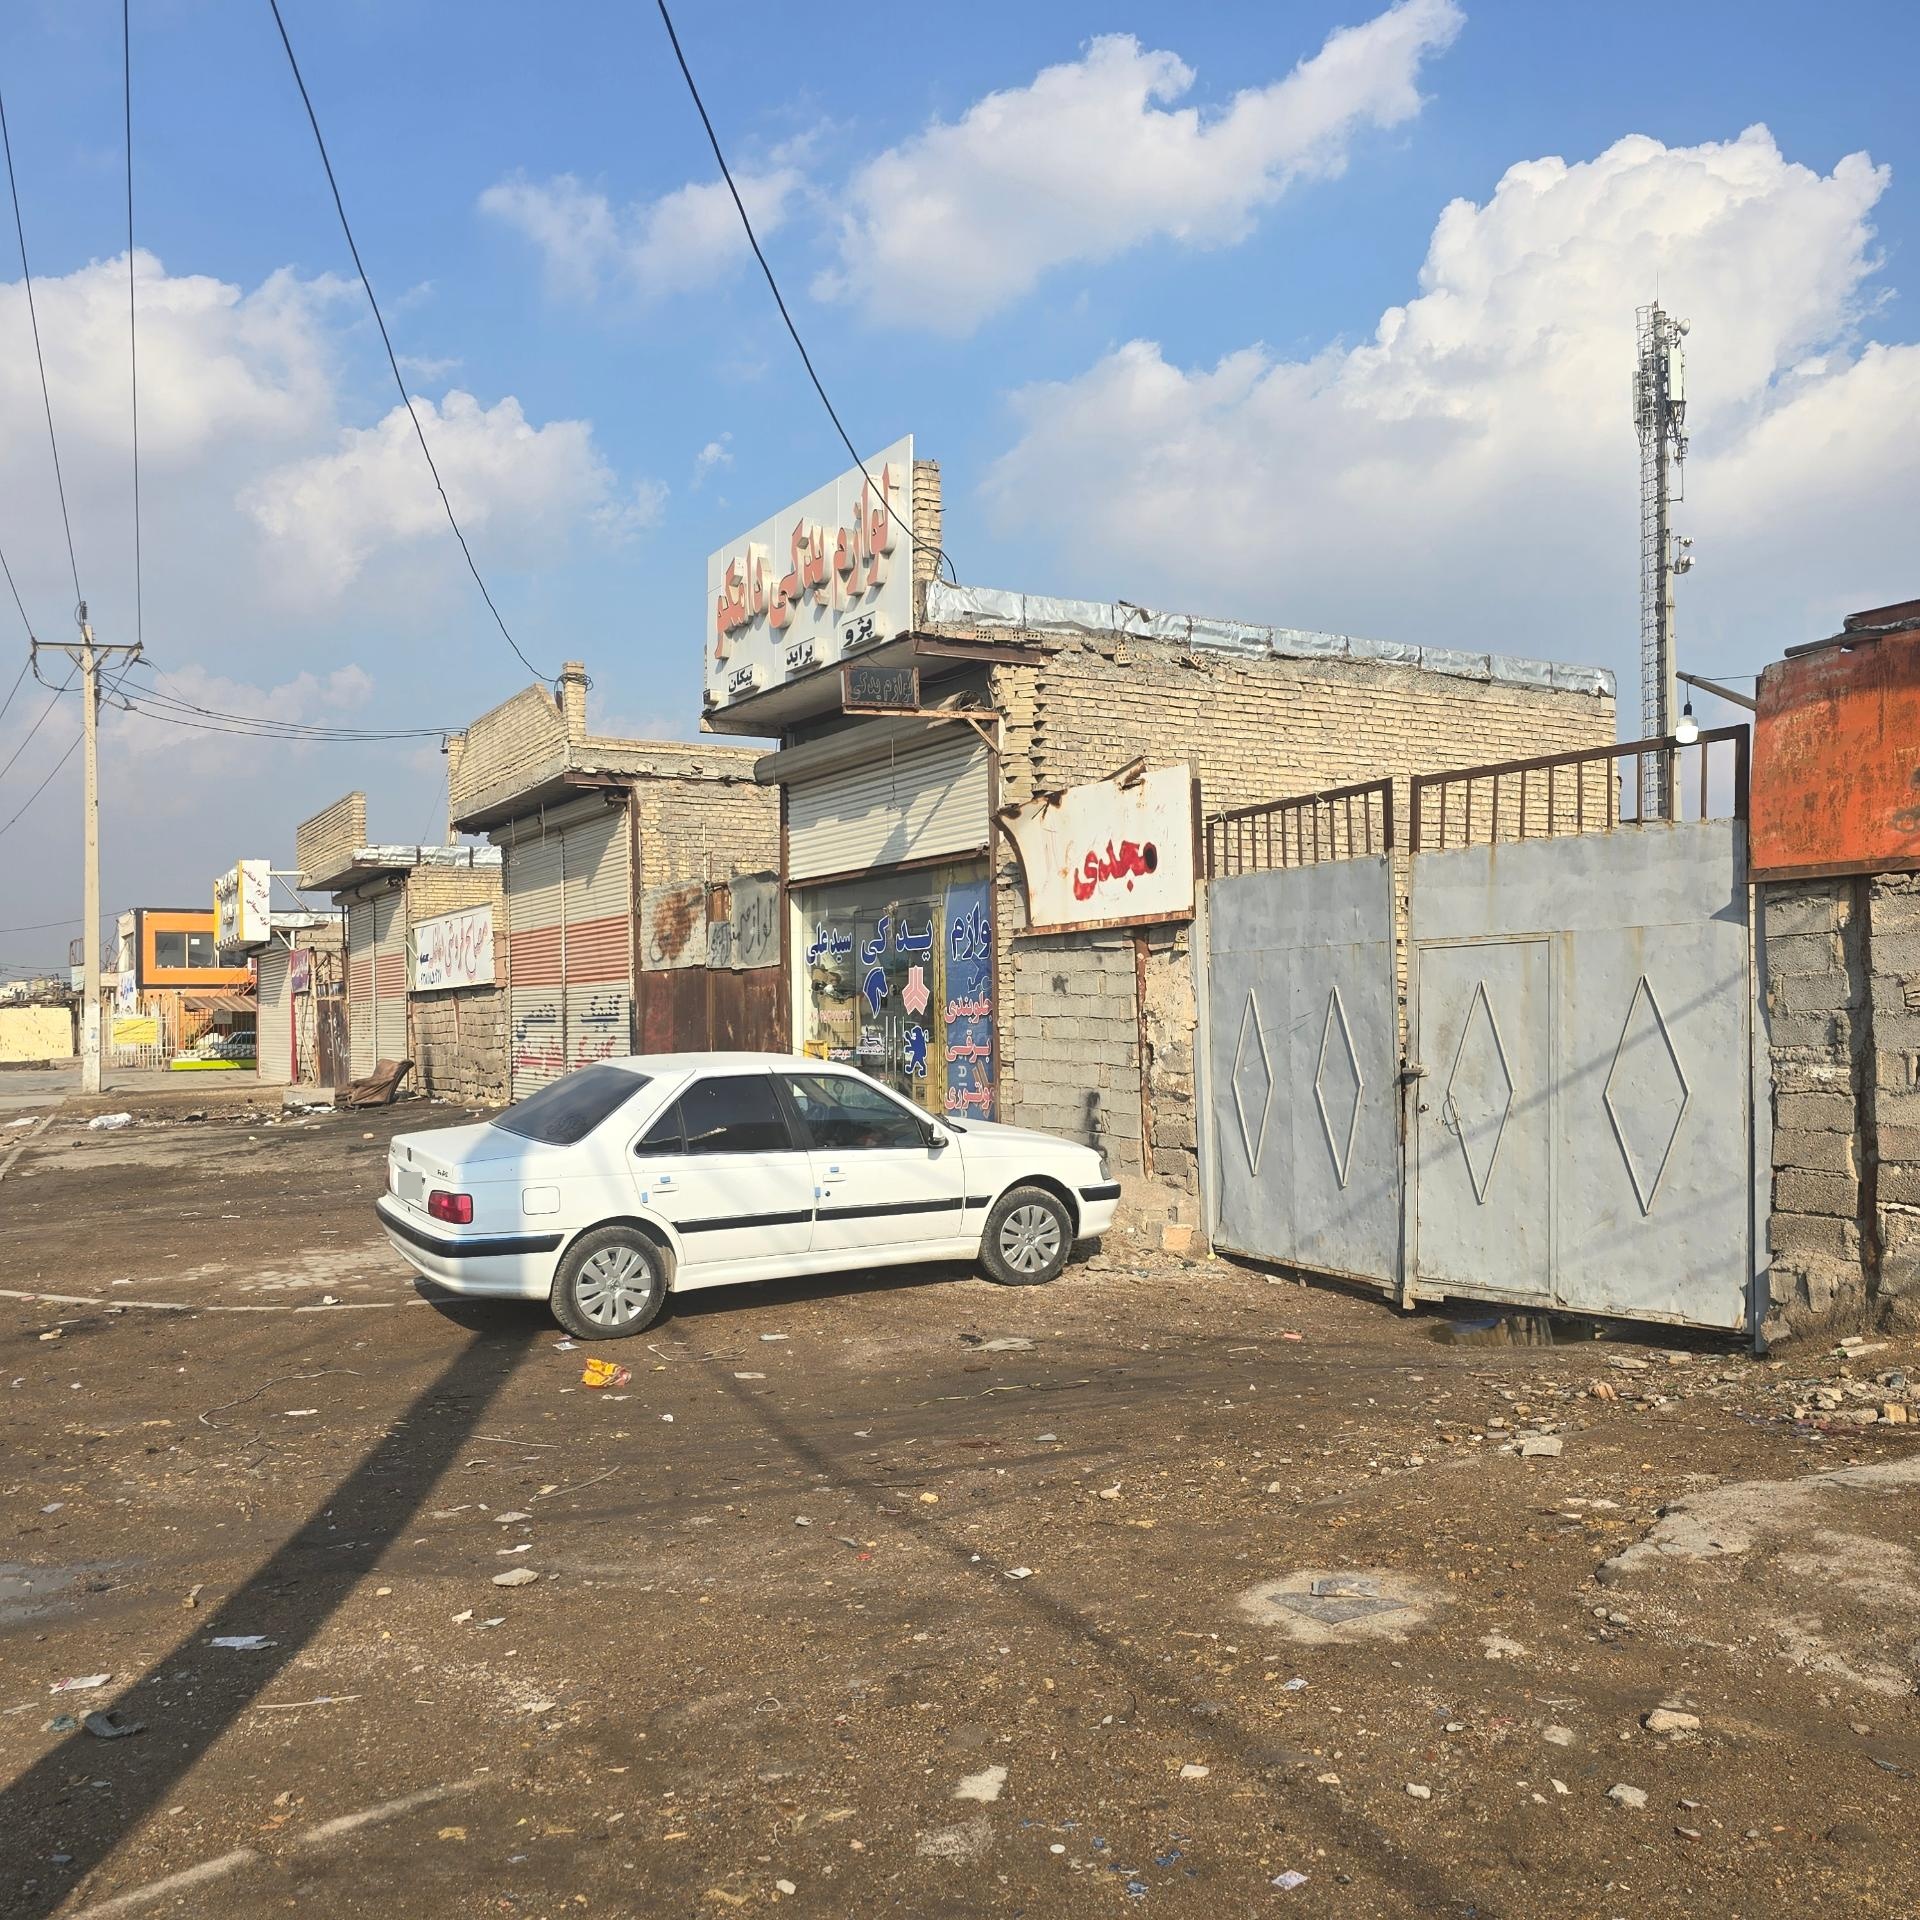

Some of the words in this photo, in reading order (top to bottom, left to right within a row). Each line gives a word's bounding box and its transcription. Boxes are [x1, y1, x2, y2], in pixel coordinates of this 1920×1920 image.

[833, 462, 897, 612] لوازم
[769, 518, 831, 629] یدکی
[843, 615, 874, 648] پژو
[786, 643, 814, 666] پراید
[728, 669, 754, 692] پیکان
[884, 671, 914, 703] لوازم
[1073, 838, 1158, 902] مجدی
[950, 900, 993, 961] وازم
[945, 1029, 992, 1064] برقی
